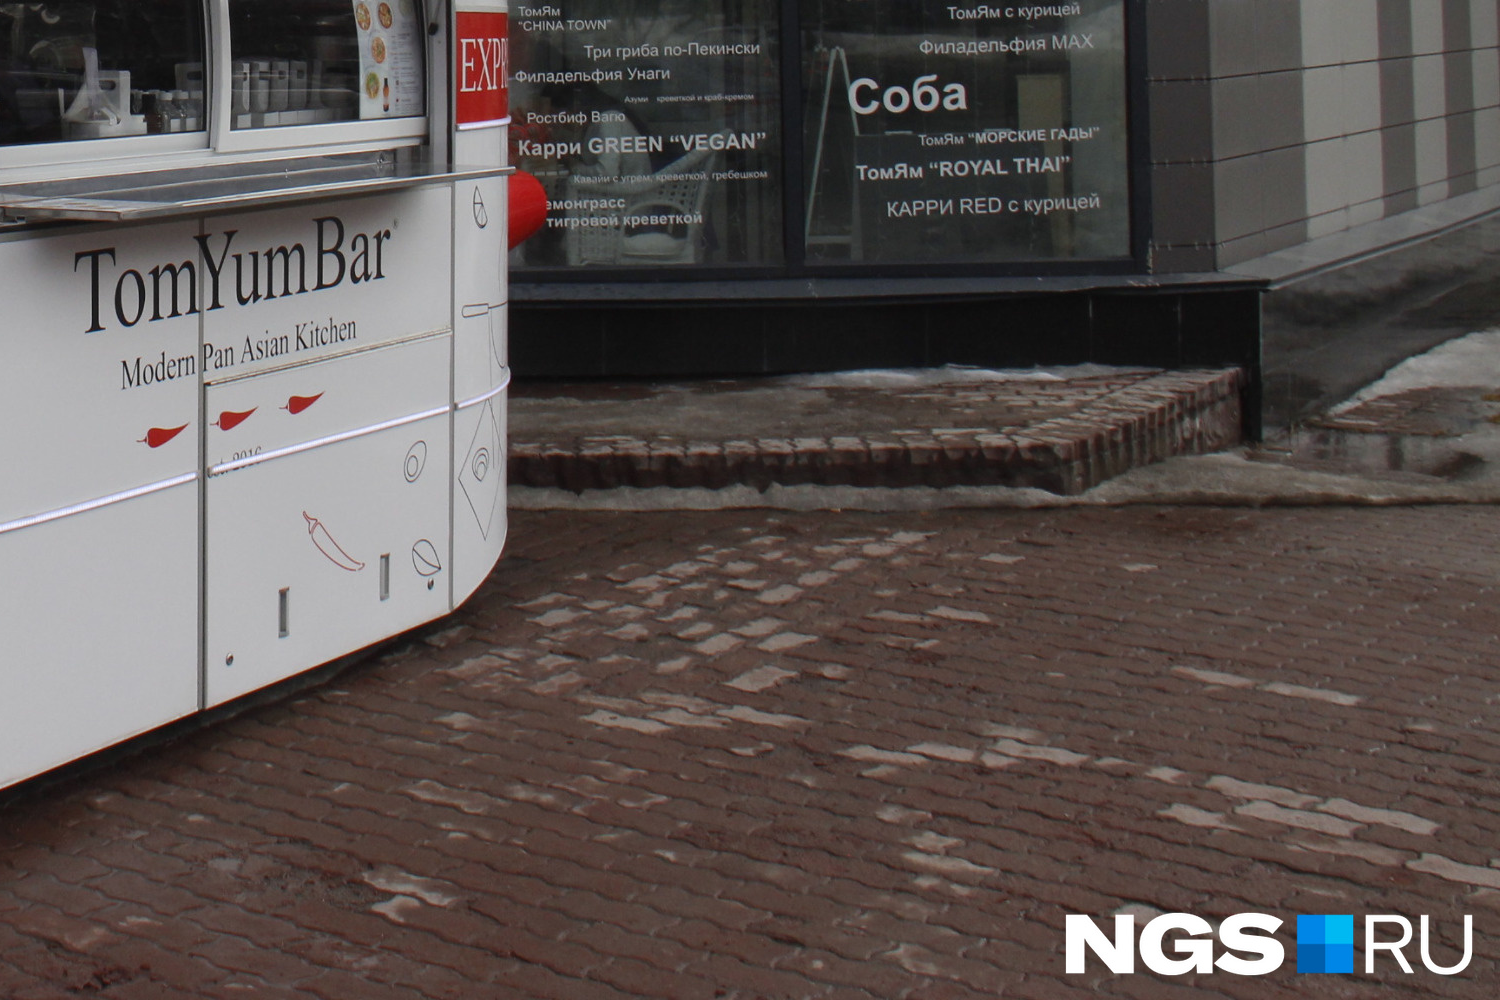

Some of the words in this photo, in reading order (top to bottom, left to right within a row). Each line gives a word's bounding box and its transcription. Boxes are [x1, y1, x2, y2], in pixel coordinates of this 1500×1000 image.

[518, 6, 560, 17] ТомЯм
[948, 5, 1000, 19] ТомЯм
[1005, 7, 1014, 17] с
[1018, 2, 1080, 19] курицей
[583, 45, 611, 60] Три
[616, 43, 659, 59] гриба
[664, 42, 760, 57] по-Пекински
[920, 36, 1046, 55] Филадельфия
[1051, 33, 1095, 50] MAX
[515, 68, 622, 84] Филадельфия
[627, 67, 671, 81] Унаги
[848, 74, 967, 115] Соба
[527, 111, 587, 126] Ростбиф
[591, 111, 626, 123] Вагю
[518, 140, 581, 159] Карри
[588, 136, 663, 154] GREEN
[919, 134, 964, 147] ТомЯм
[712, 170, 768, 181] гребешком
[856, 164, 923, 180] ТомЯм
[546, 198, 625, 211] емонграсс
[888, 200, 953, 217] КАРРИ
[960, 198, 1002, 213] RED
[1008, 201, 1018, 212] с
[1024, 194, 1100, 215] курицей
[623, 211, 703, 227] креветкой
[74, 216, 392, 334] TomYumBar
[121, 351, 195, 390] Modern
[202, 343, 235, 372] Pan
[240, 335, 289, 364] Asian
[295, 317, 357, 352] Kitchen
